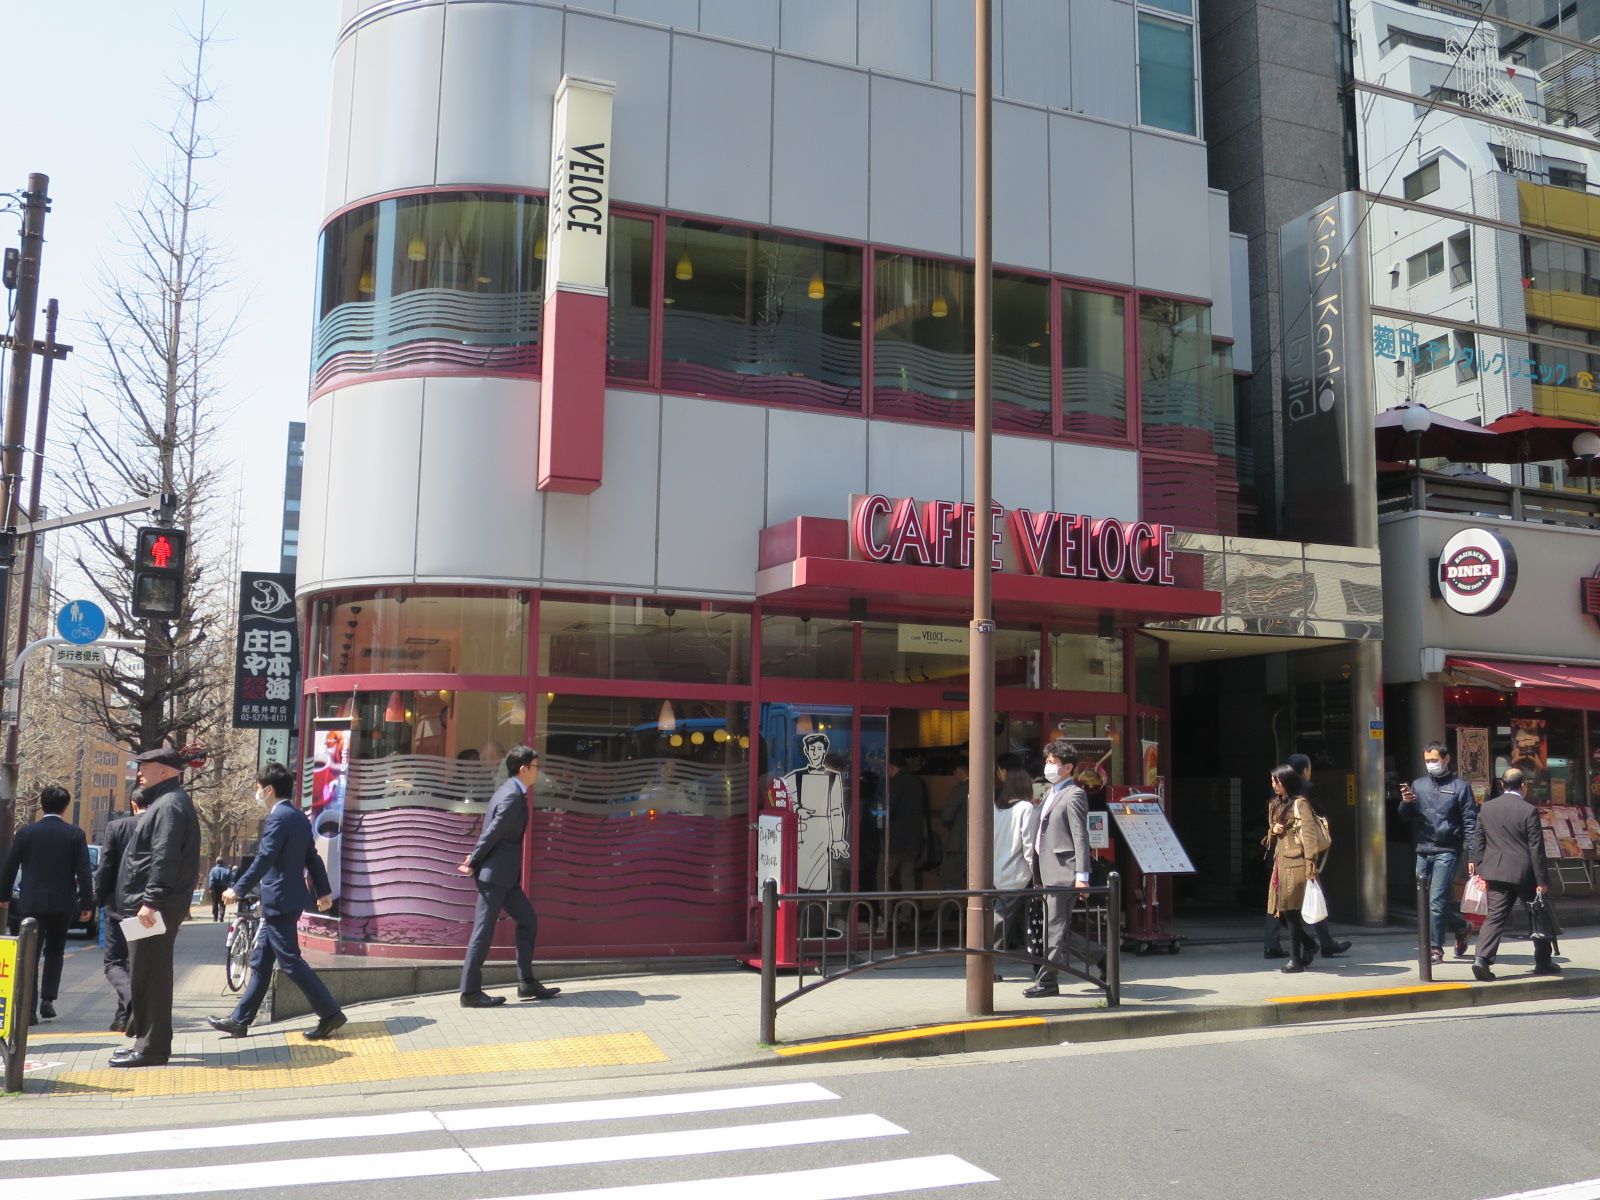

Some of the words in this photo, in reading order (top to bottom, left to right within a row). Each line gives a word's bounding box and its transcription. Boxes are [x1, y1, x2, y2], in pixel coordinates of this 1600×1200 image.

[567, 143, 605, 236] VELOCE
[1314, 206, 1336, 277] Kioi
[1018, 508, 1175, 585] VELOCE
[1447, 564, 1491, 578] DINER
[243, 628, 269, 676] 庄や
[922, 631, 944, 642] VELOCE
[57, 650, 100, 661] 歩行者優先
[265, 630, 292, 701] 日本海
[240, 713, 287, 722] 03-5276-8131
[242, 705, 287, 714] 紀尾井町店
